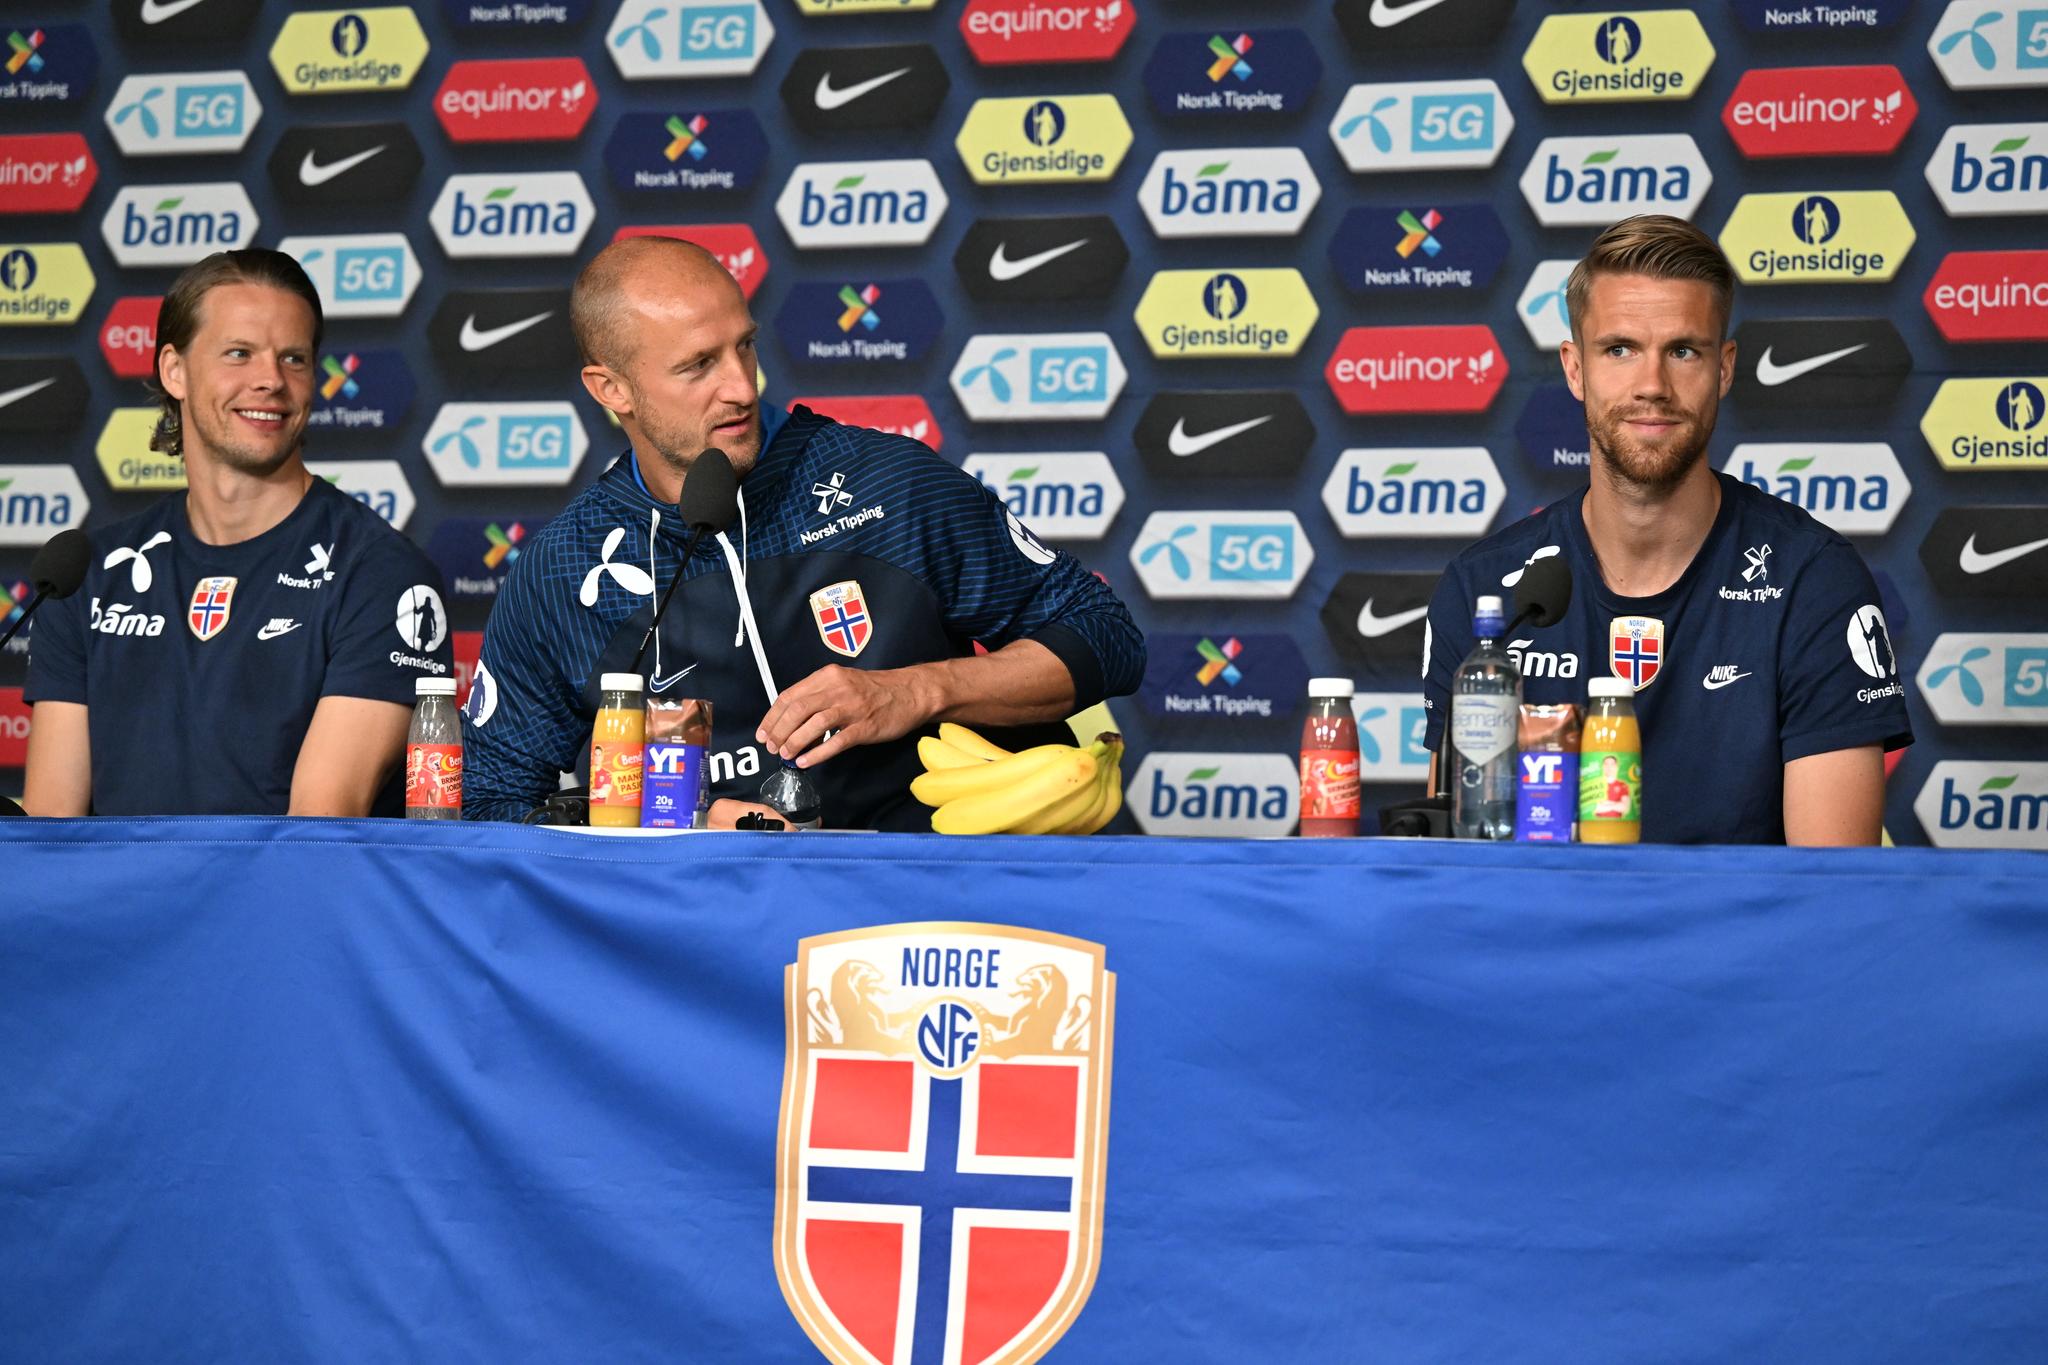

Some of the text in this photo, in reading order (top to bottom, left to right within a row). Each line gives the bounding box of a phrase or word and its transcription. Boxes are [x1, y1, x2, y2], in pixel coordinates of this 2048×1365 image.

[470, 4, 567, 23] Norsk Tipping
[968, 3, 1091, 41] equinor
[1765, 6, 1878, 27] Norsk Tipping
[687, 14, 747, 50] 5G
[2024, 21, 2048, 58] 5
[0, 81, 69, 100] rsk Tipping
[295, 61, 402, 89] Gjensidige
[1552, 67, 1684, 97] Gjensidige
[182, 93, 237, 128] 5G
[441, 85, 556, 118] equinor
[1177, 90, 1283, 110] Norsk Tipping
[1732, 93, 1867, 132] equinor
[1418, 104, 1485, 141] 5G
[635, 169, 734, 190] Norsk Tipping
[983, 149, 1105, 178] Gjensidige
[1545, 154, 1691, 204] bama
[1951, 142, 2048, 194] bam
[799, 179, 928, 227] bama
[1161, 167, 1300, 216] bama
[122, 201, 240, 247] bama
[451, 191, 577, 237] bama
[340, 256, 396, 290] 5G
[1365, 266, 1473, 288] Norsk Tipping
[1749, 250, 1884, 279] Gjensidige
[0, 295, 70, 322] nsidige
[1934, 276, 2048, 317] equino
[808, 340, 906, 360] Norsk Tipping
[1163, 325, 1288, 353] Gjensidige
[1038, 357, 1098, 393] 5G
[1335, 351, 1461, 389] equinor
[335, 406, 383, 428] Tipping
[504, 424, 563, 460] 5G
[1553, 448, 1590, 466] Nors
[1952, 434, 2048, 465] Gjensid
[119, 458, 188, 486] Gjensi
[0, 490, 71, 525] ma
[1346, 466, 1486, 516] bama
[800, 505, 884, 546] Norsk Tipping
[1217, 535, 1285, 571] 5G
[277, 572, 311, 589] Norsk
[91, 597, 165, 636] bama
[267, 618, 294, 632] NIKE
[389, 650, 446, 675] Gjensidige
[1711, 665, 1738, 681] NIKE
[2014, 659, 2048, 696] 5
[1165, 694, 1271, 716] Norsk Tipping
[621, 752, 642, 766] Bend
[617, 772, 643, 784] MANG
[1151, 769, 1288, 820] bama
[656, 795, 673, 806] 20g
[1940, 778, 2048, 831] bam
[901, 947, 1000, 988] NORGE
[918, 1002, 978, 1069] NFF
